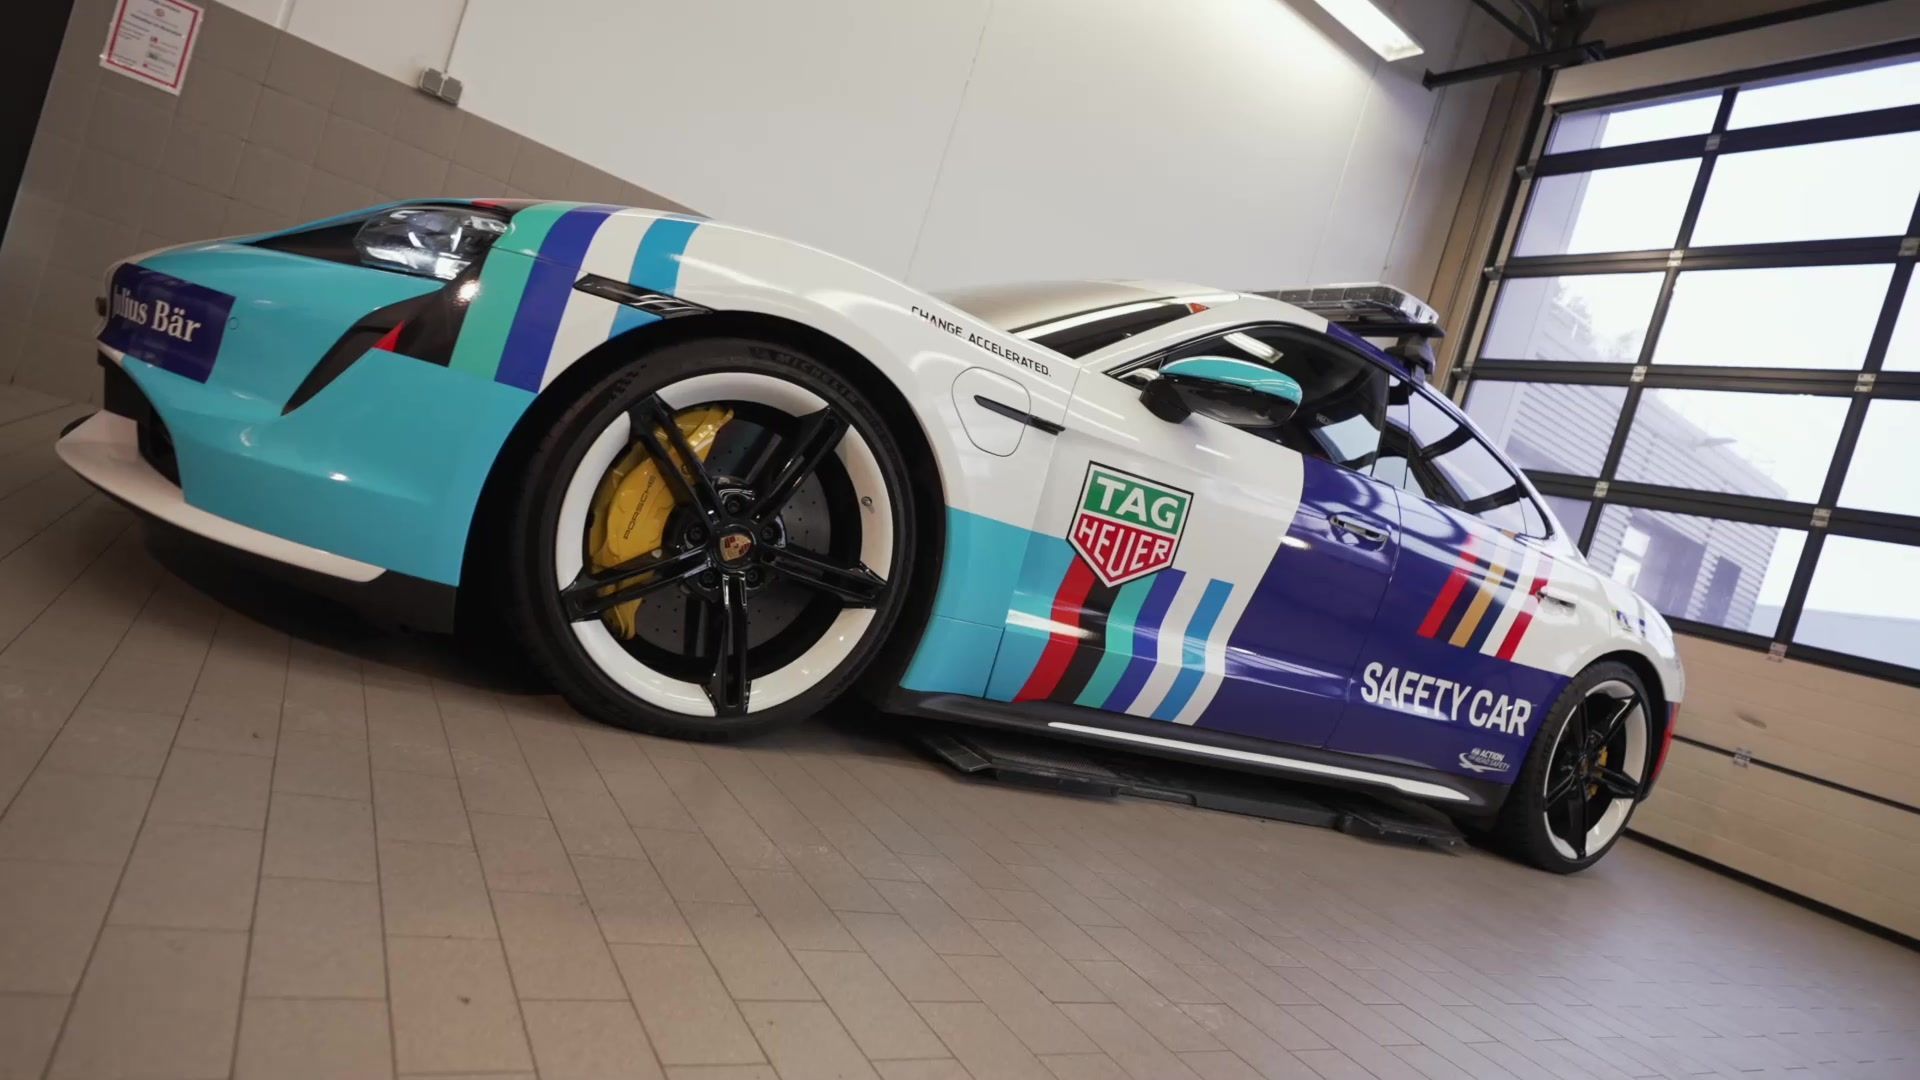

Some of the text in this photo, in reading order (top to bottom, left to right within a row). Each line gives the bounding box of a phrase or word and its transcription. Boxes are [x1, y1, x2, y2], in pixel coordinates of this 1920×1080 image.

[151, 300, 201, 342] Bär
[968, 333, 1051, 377] ACCELERATED.
[1097, 476, 1179, 529] TAG
[1078, 518, 1170, 578] HEUER
[1360, 661, 1532, 736] SAFETY CAR
